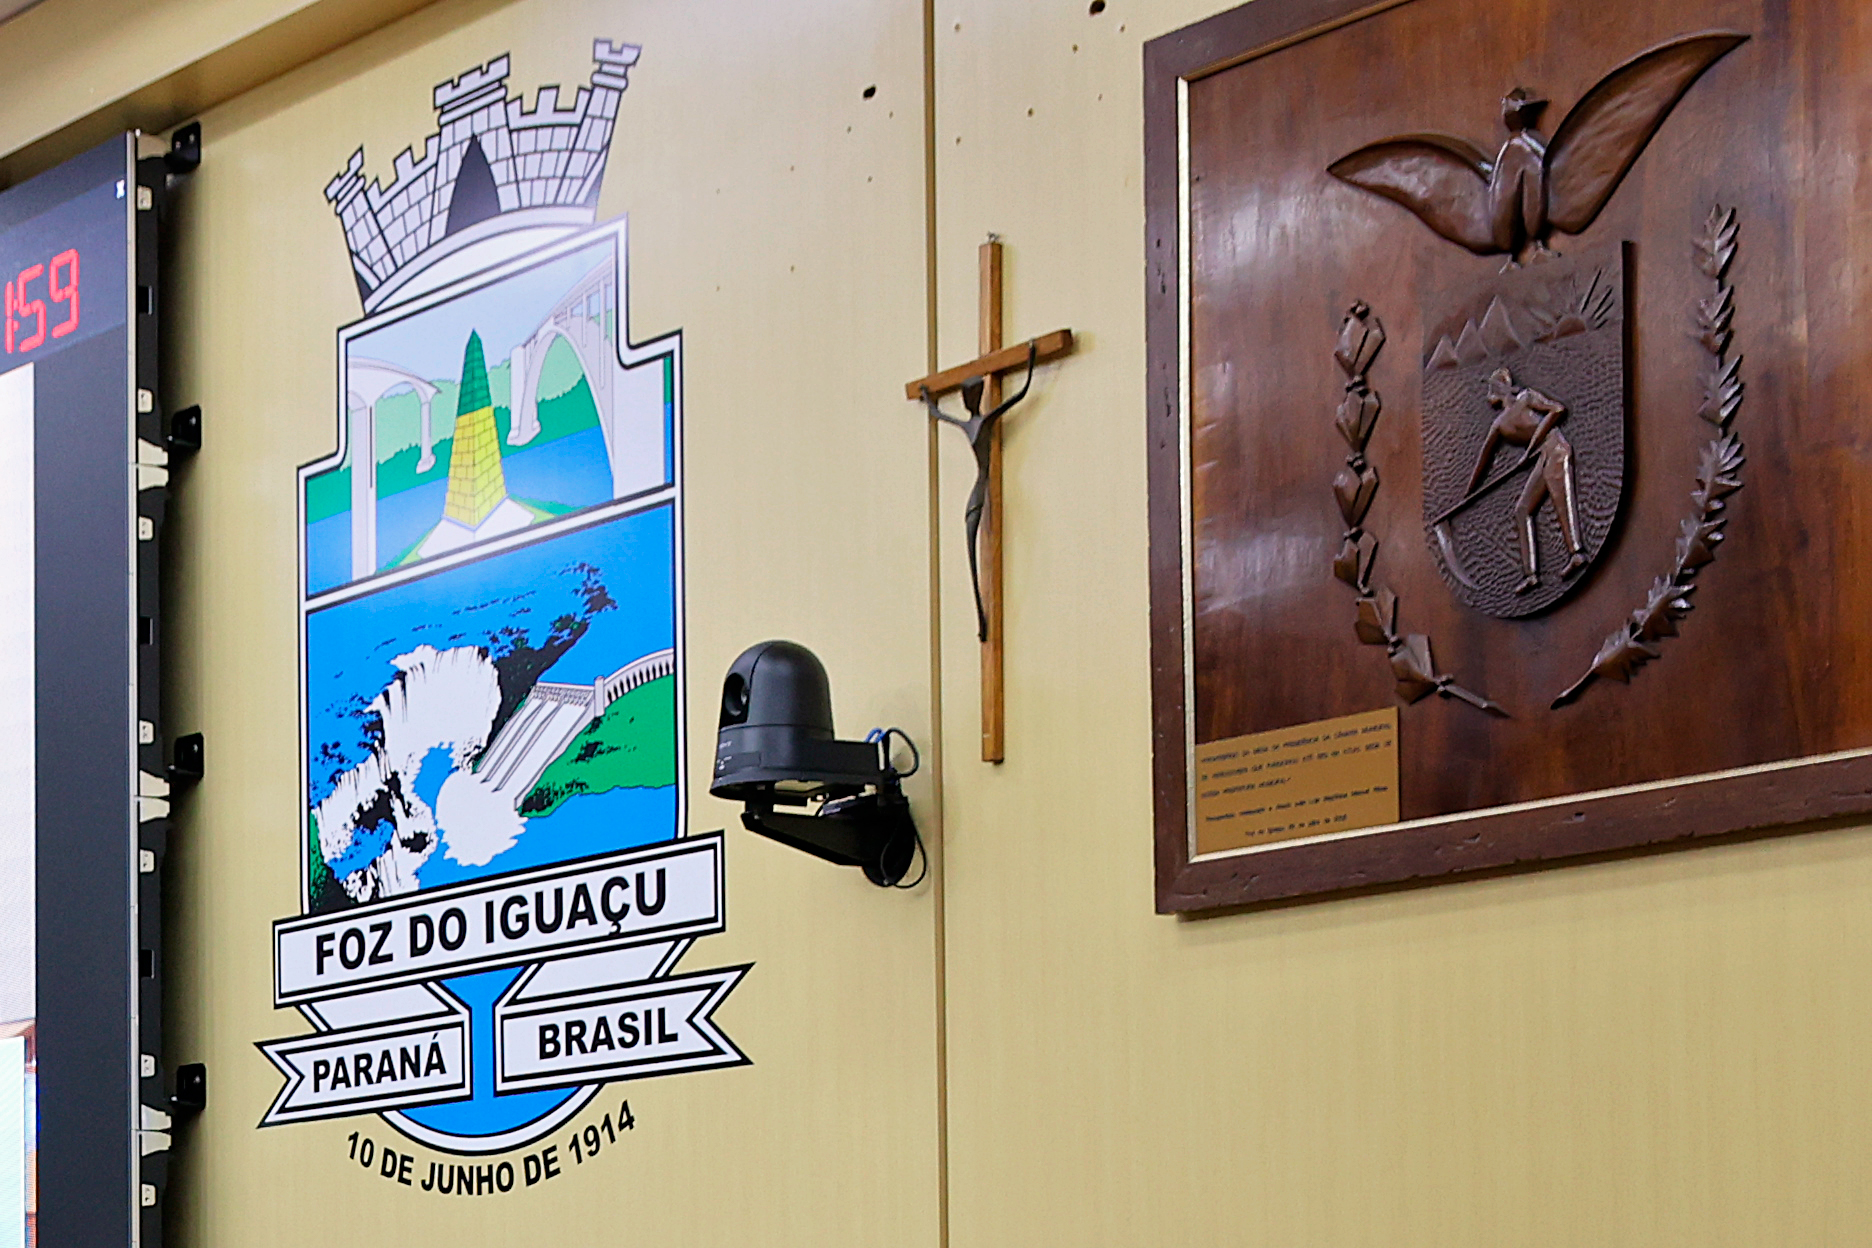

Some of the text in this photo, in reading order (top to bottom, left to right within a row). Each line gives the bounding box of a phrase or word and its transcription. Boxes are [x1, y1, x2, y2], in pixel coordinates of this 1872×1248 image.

[315, 868, 667, 976] FOZ DO IGUAÇU
[312, 1033, 447, 1093] PARANÁ
[538, 1006, 679, 1060] BRASIL
[346, 1099, 636, 1196] 10 DE JUNHO DE 1914
